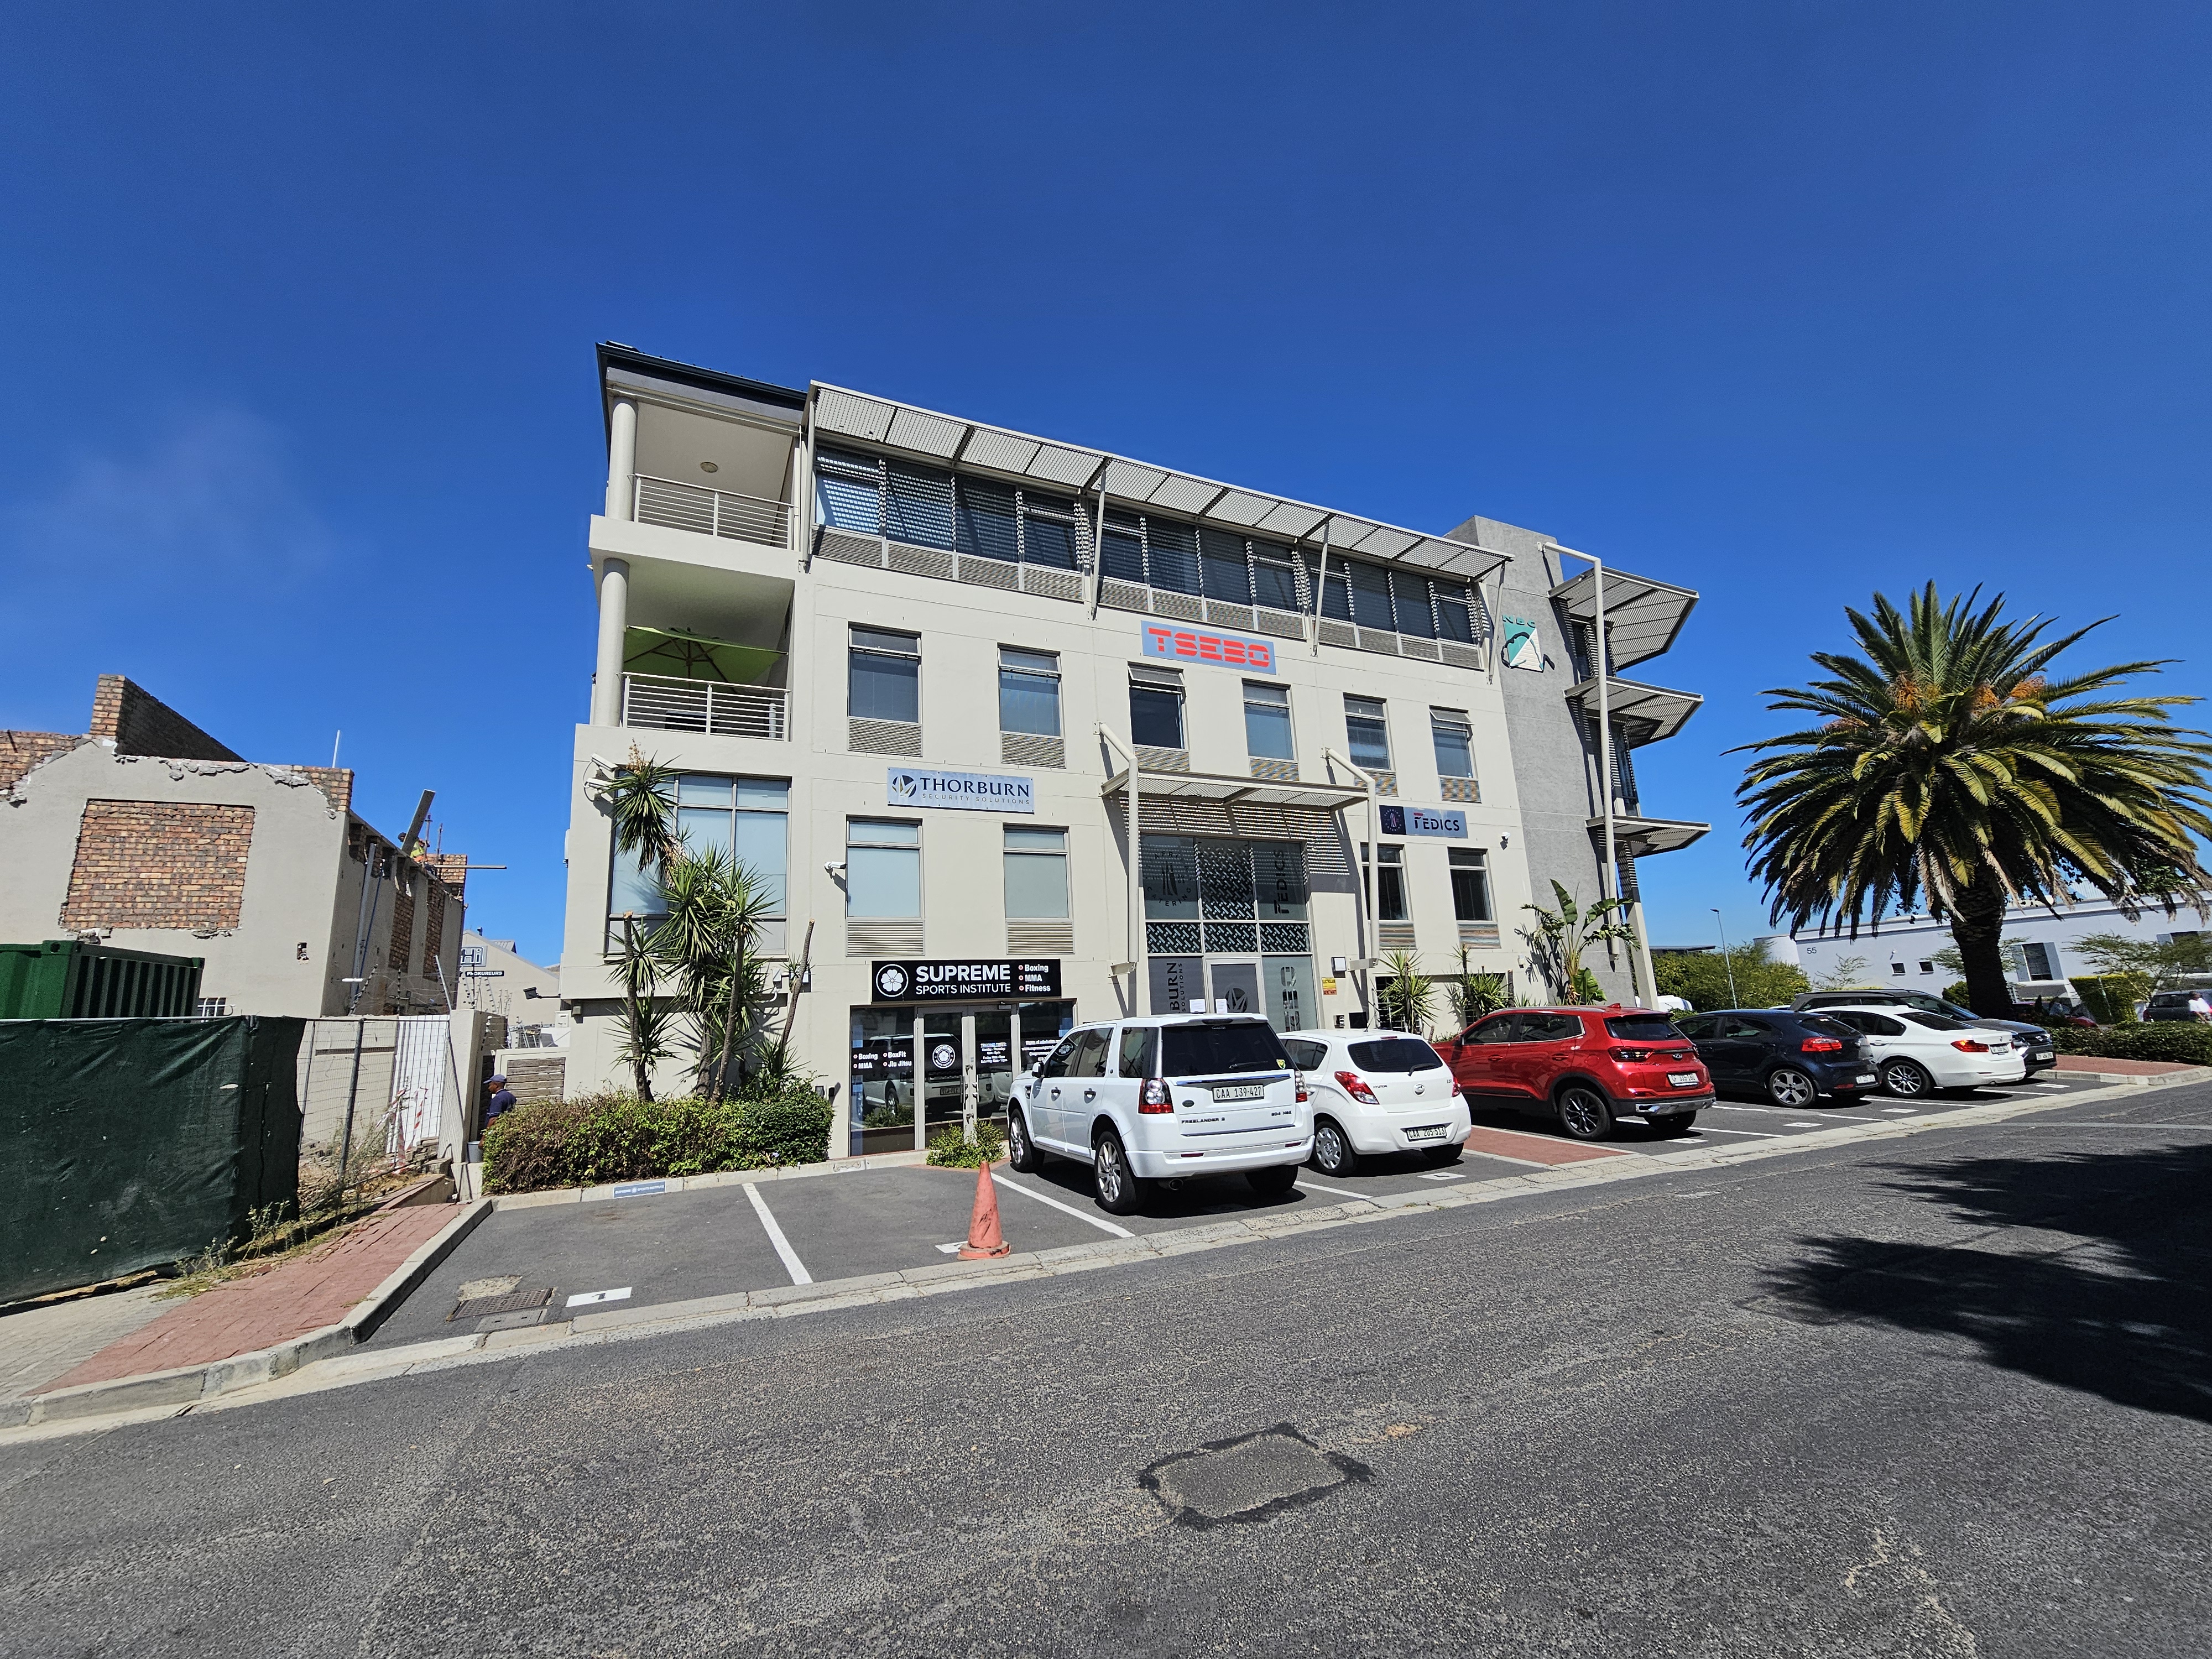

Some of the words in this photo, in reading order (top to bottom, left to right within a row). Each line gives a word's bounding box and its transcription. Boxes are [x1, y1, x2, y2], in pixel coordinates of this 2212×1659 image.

[1148, 627, 1270, 667] TSEBO
[920, 777, 1030, 797] THORBURN
[922, 793, 969, 801] SECURITY
[976, 796, 1030, 805] SOLUTIONS
[1147, 886, 1192, 907] CATERING
[916, 964, 1011, 983] SUPREME
[1025, 964, 1048, 973] Boxing
[1025, 974, 1042, 982] MMA
[916, 984, 957, 995] SPORTS
[960, 983, 1011, 994] INSTITUTE
[1025, 984, 1051, 992] Fitness
[1216, 1089, 1230, 1098] CAA
[1234, 1086, 1261, 1098] 139-427
[1409, 1130, 1421, 1139] CAA
[1422, 1126, 1445, 1136] 205-513
